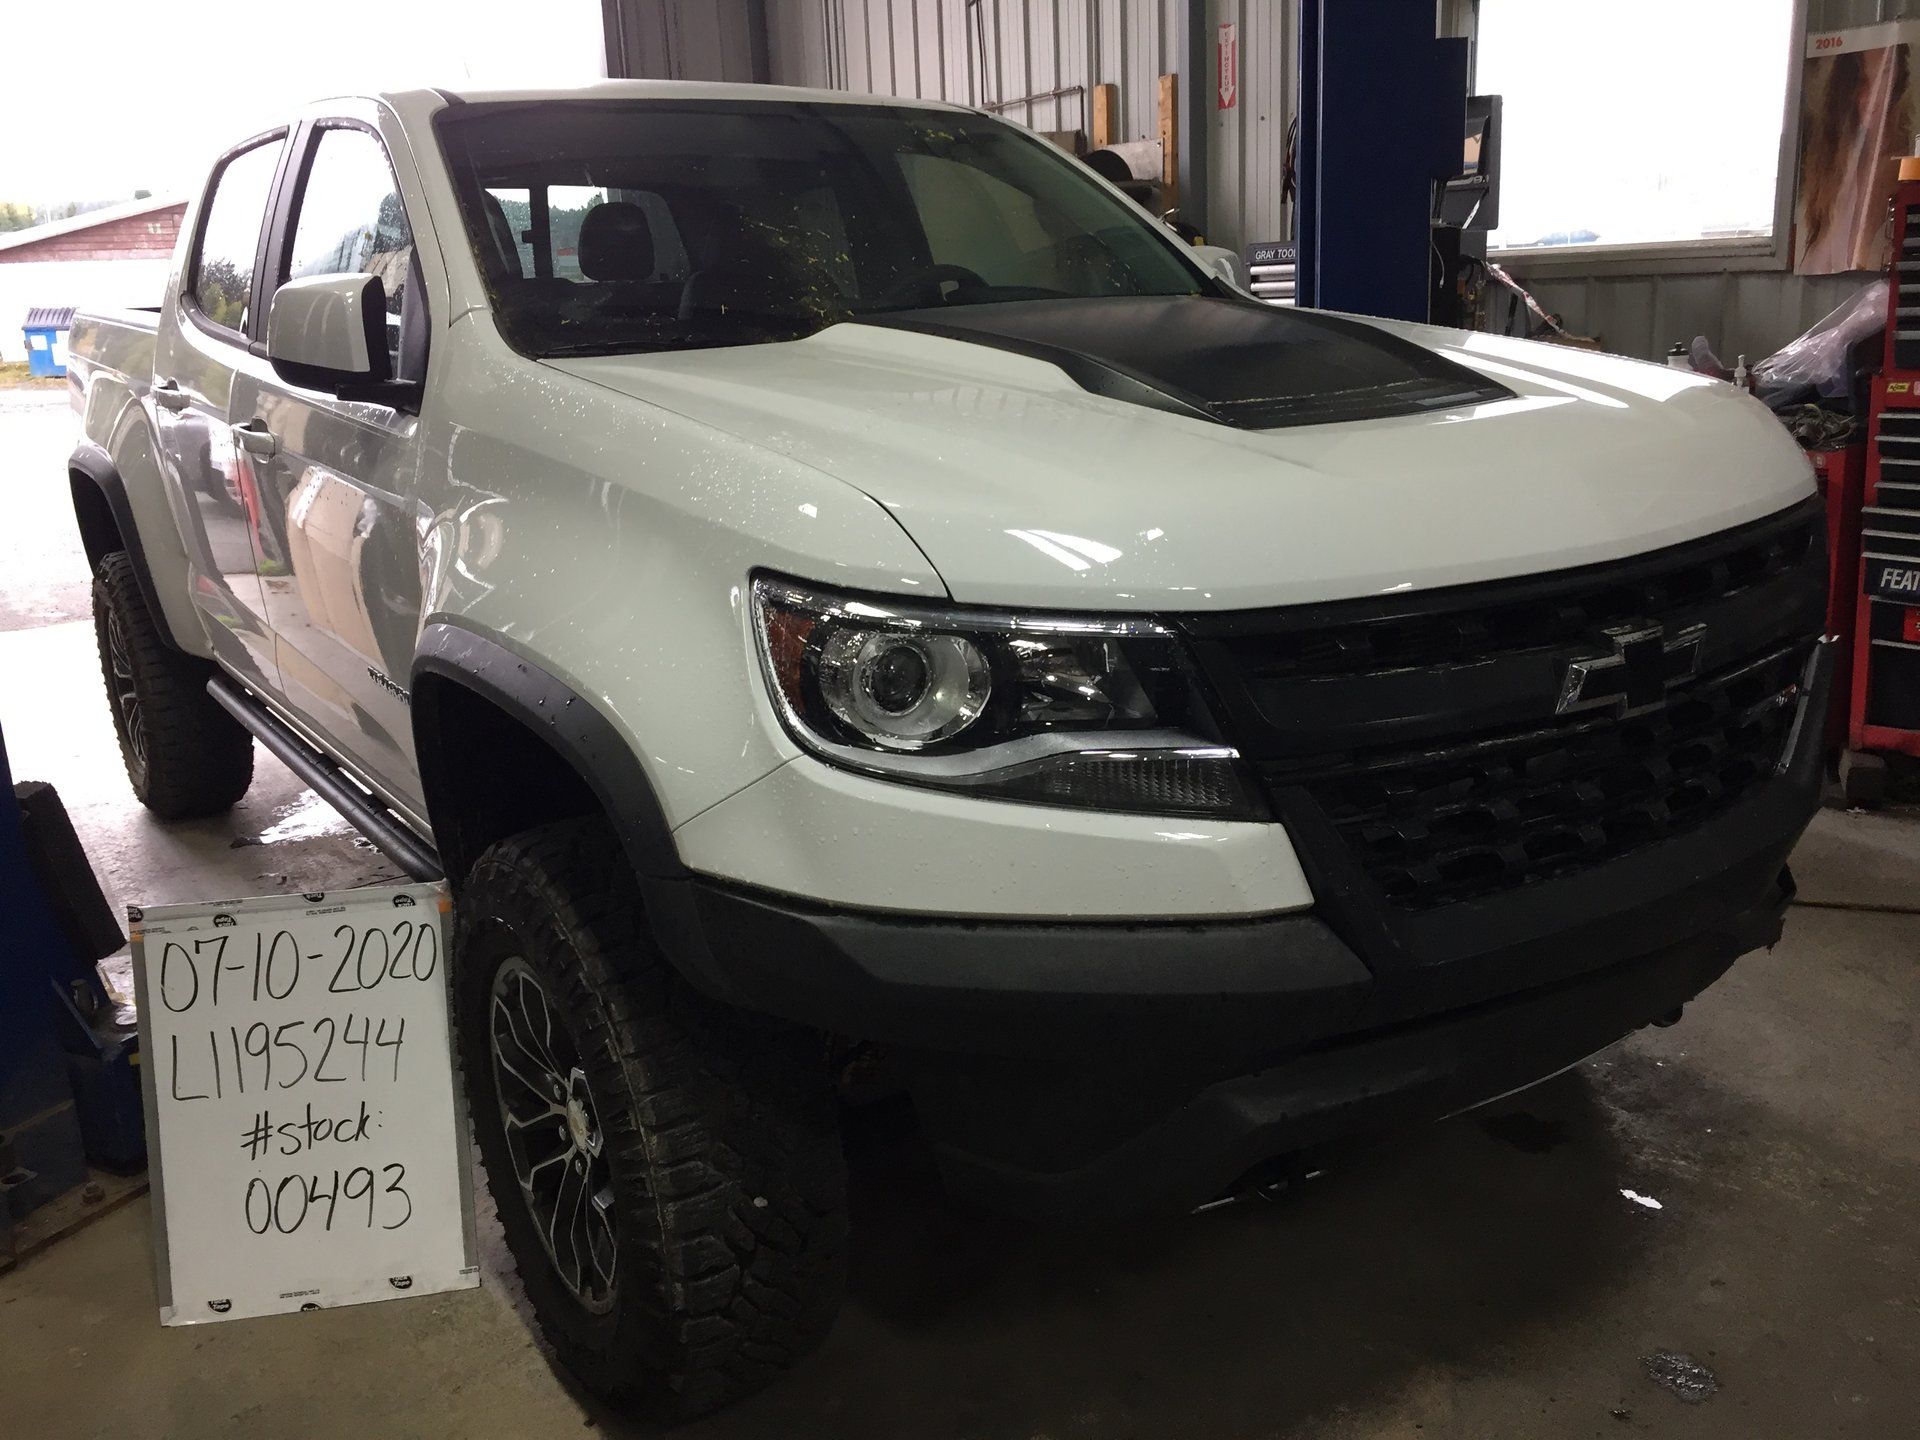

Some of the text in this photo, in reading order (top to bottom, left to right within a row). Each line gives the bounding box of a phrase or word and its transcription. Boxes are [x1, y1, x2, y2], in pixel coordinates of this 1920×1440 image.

[1815, 36, 1843, 50] 2016
[1255, 249, 1276, 260] GRAY
[160, 920, 437, 1012] 07-10-2020
[171, 1013, 405, 1102] L1195244
[244, 1162, 412, 1235] 00493
